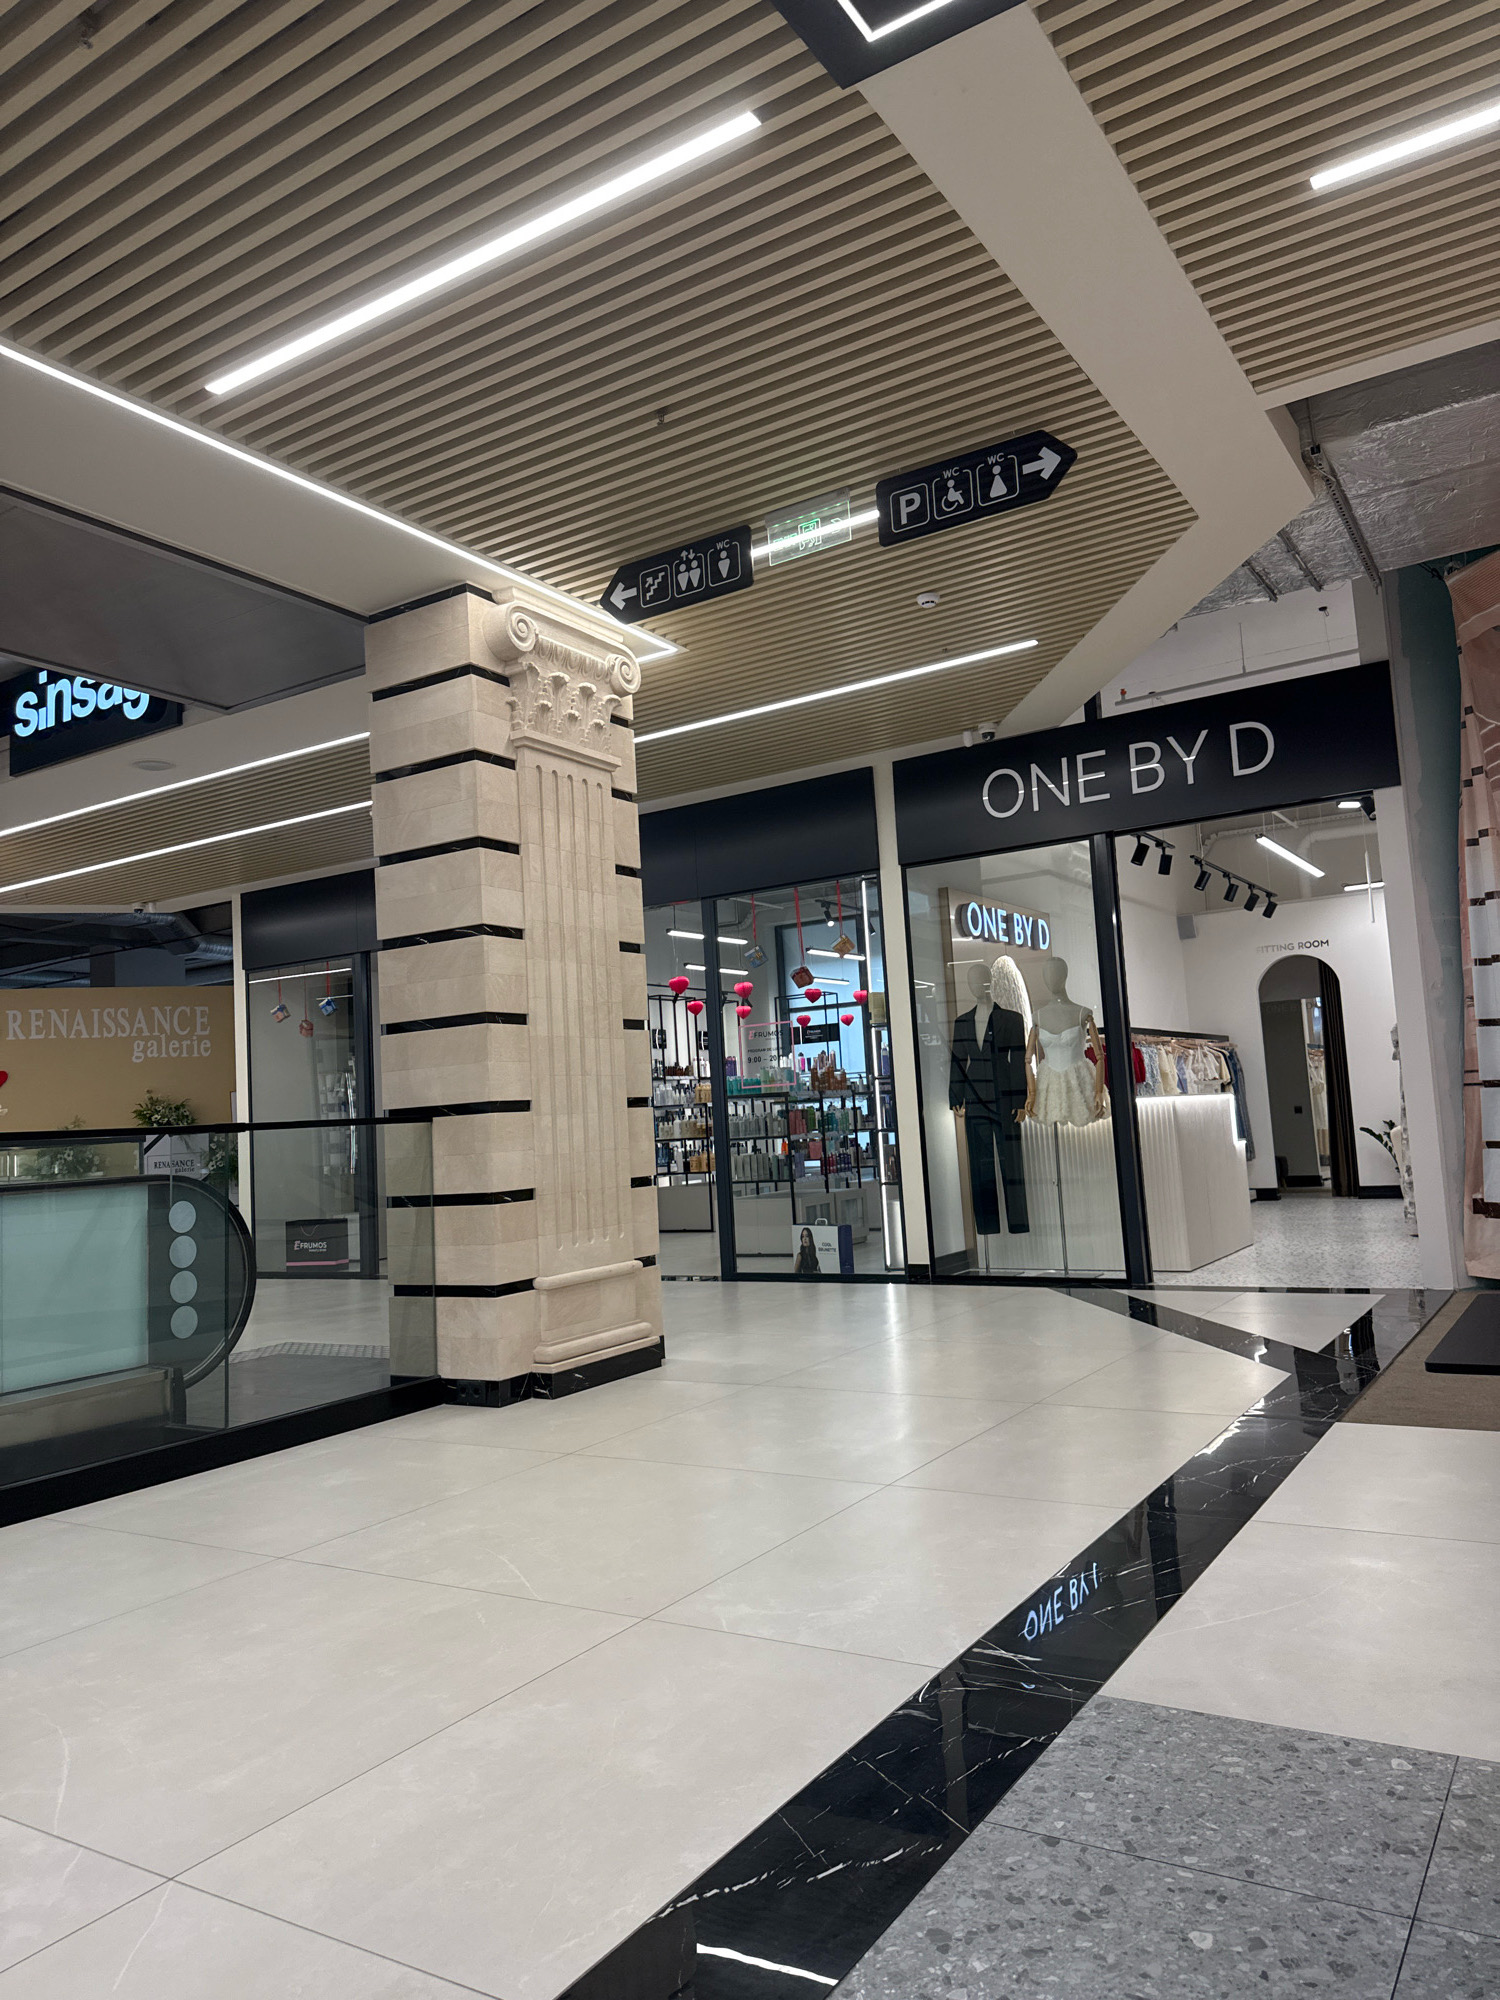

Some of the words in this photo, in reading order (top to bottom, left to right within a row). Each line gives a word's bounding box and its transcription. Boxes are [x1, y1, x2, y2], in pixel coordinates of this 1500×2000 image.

[942, 466, 960, 479] WC
[987, 453, 1005, 465] WC
[900, 492, 921, 525] P
[716, 539, 730, 550] WC
[982, 749, 1111, 819] ONE
[1128, 729, 1209, 795] BY
[1229, 721, 1275, 777] D
[967, 902, 1009, 943] ONE
[1013, 912, 1033, 947] BY
[1038, 919, 1050, 950] D
[1256, 943, 1295, 954] FITTING
[1297, 939, 1329, 950] ROOM
[6, 1006, 211, 1041] RENAISSANCE
[132, 1034, 212, 1063] galerie
